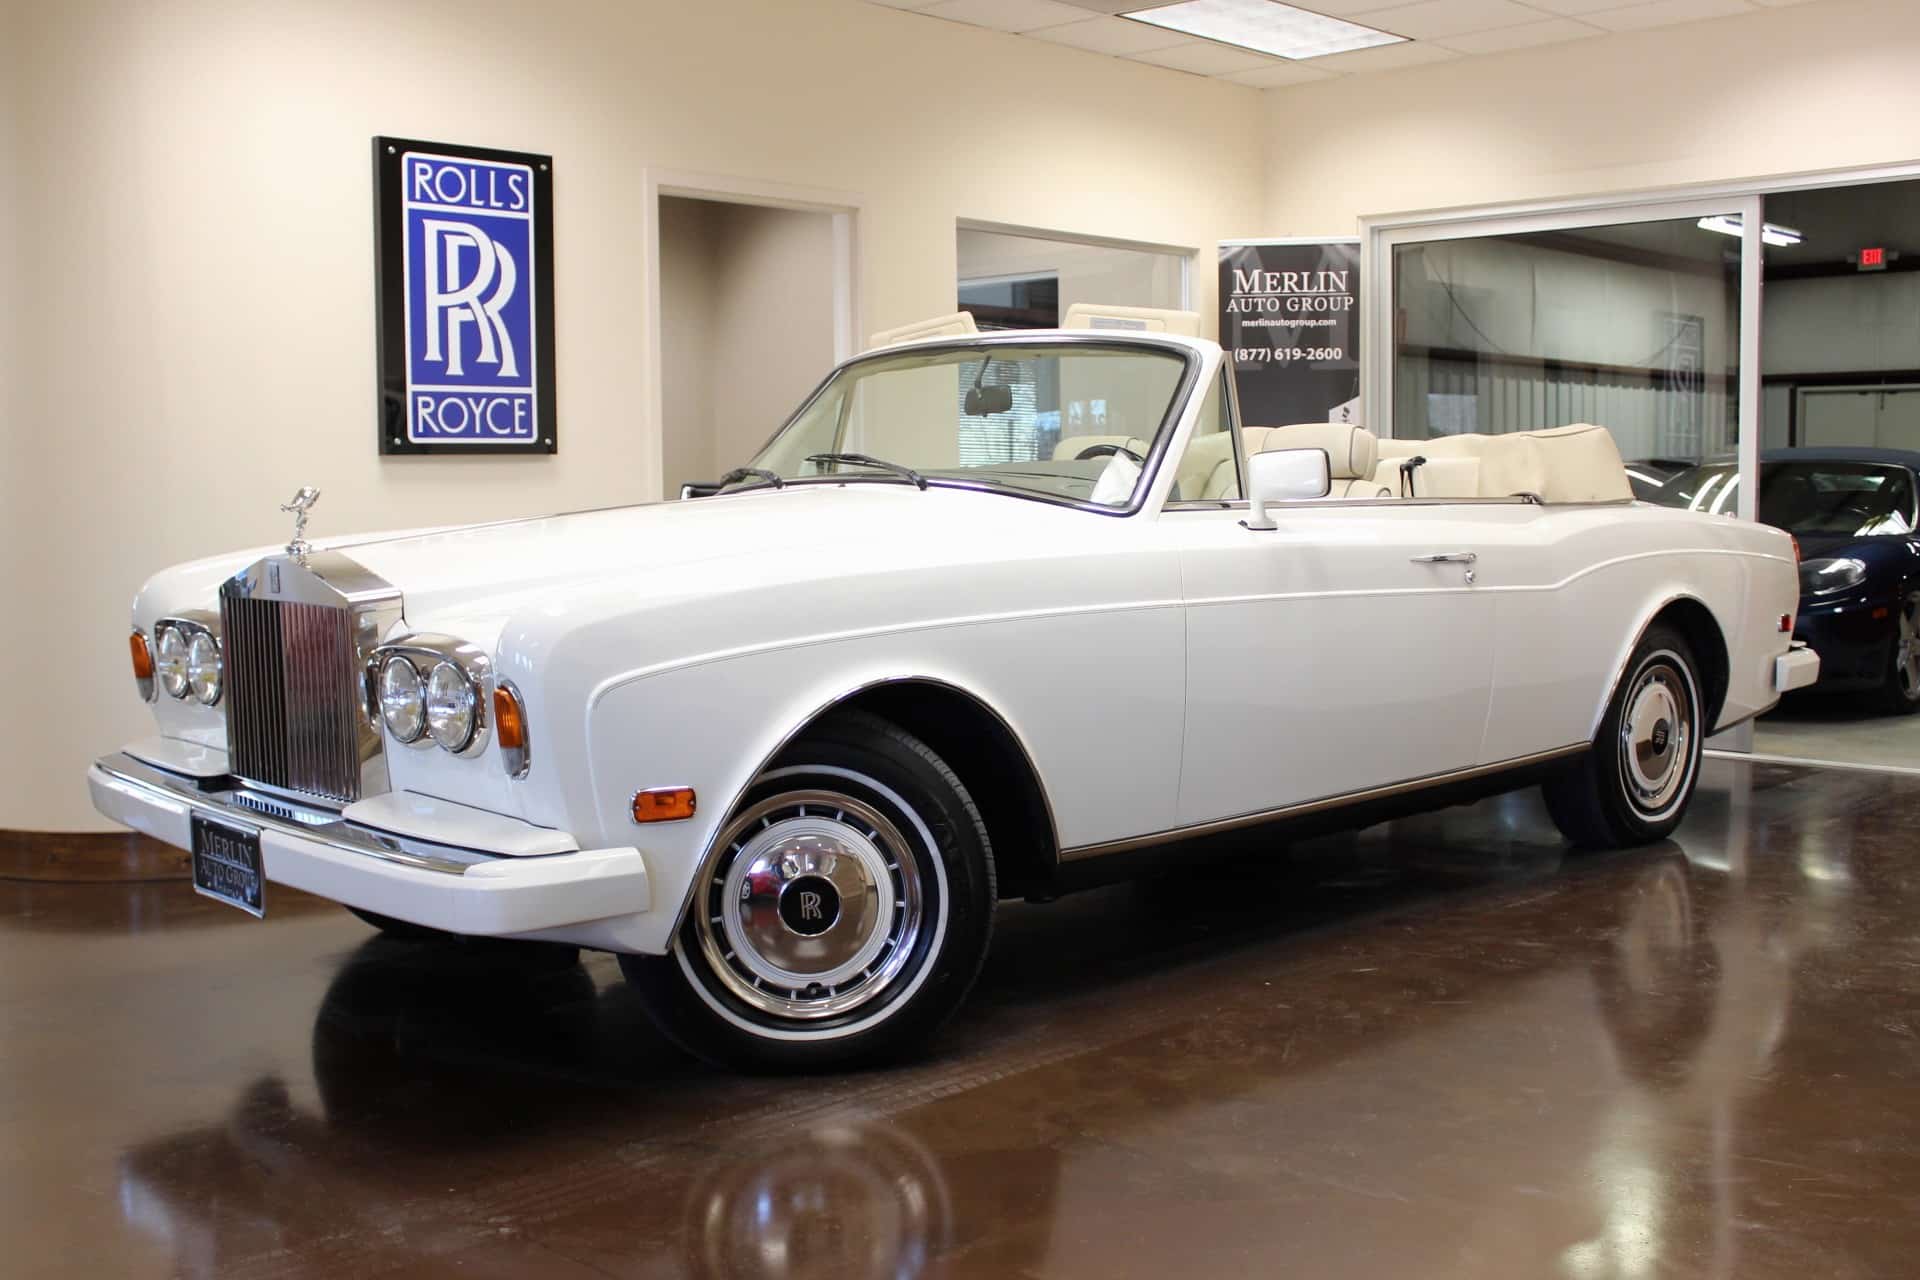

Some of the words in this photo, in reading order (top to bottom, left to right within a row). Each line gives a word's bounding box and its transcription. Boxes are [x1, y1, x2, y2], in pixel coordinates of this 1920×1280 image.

[414, 162, 525, 210] ROLLS
[1232, 269, 1349, 294] MERLIN
[422, 218, 520, 378] RR
[1226, 298, 1280, 313] AUTO
[1286, 296, 1354, 312] GROUP
[1241, 318, 1337, 329] merlinautogroup.com
[1234, 348, 1271, 363] (877)
[1274, 347, 1342, 361] 619-2600
[416, 395, 528, 434] ROYCE
[200, 827, 254, 867] MERLIN
